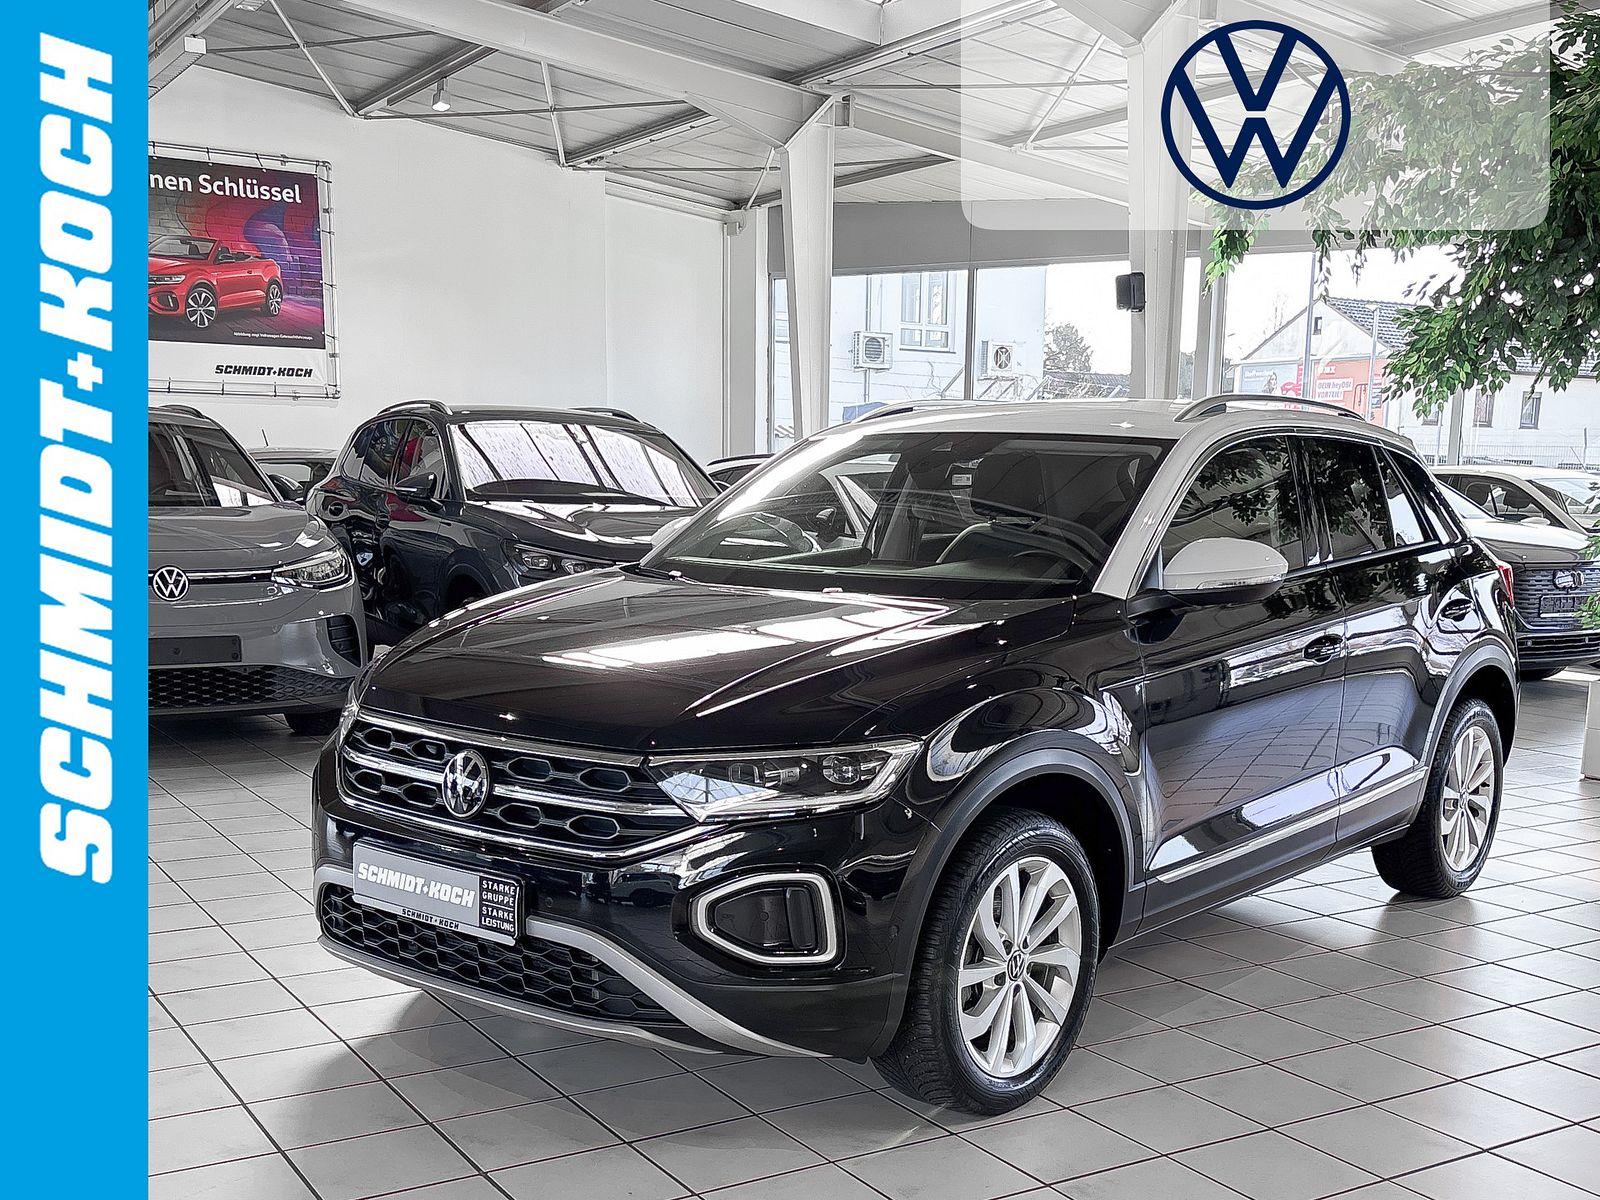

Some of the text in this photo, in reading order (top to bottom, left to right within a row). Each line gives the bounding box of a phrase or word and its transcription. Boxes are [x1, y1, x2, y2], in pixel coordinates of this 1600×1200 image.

[198, 173, 302, 204] Schlüssel
[214, 364, 314, 378] SCHMIDT+KOCH
[357, 862, 476, 909] SCHMIDT+KOCH
[482, 880, 516, 895] STARKE
[482, 890, 515, 906] GRUPPE
[482, 906, 514, 922] STARKE
[481, 916, 515, 932] LEISTUNG
